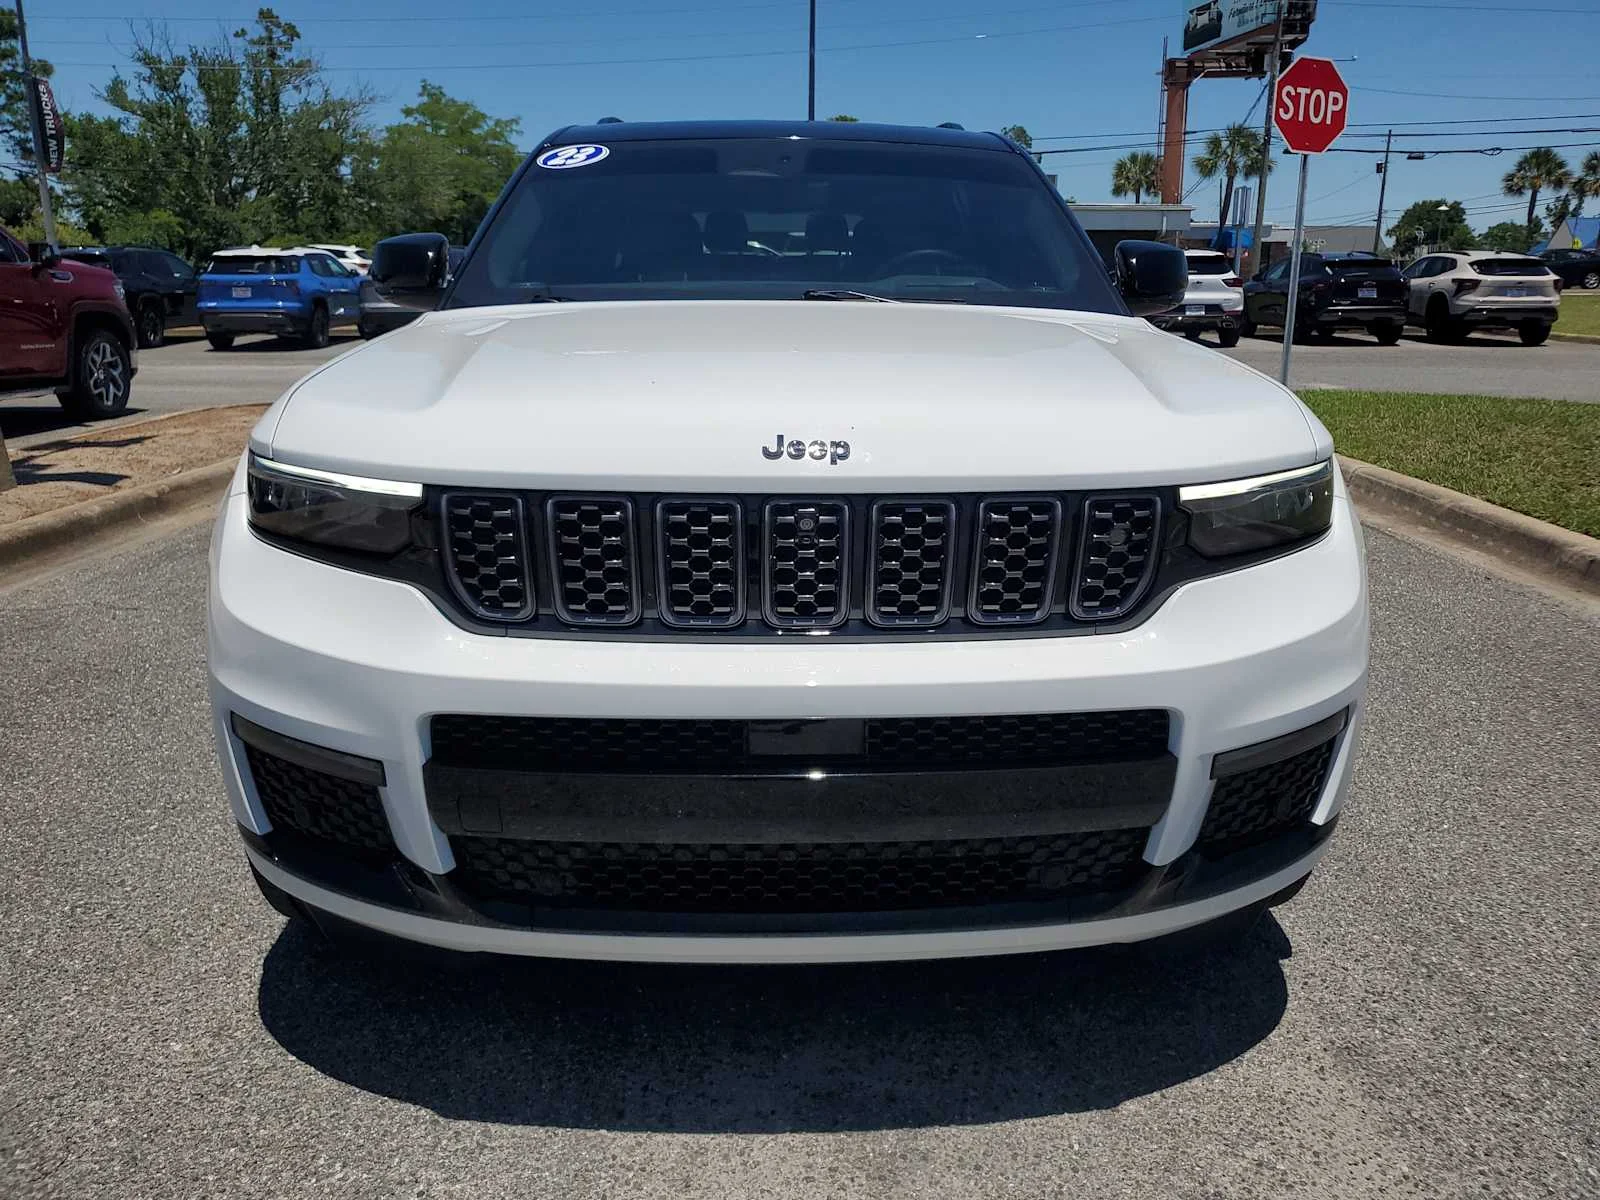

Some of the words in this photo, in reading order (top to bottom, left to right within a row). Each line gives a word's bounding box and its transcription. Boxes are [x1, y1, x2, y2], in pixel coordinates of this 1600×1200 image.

[39, 84, 56, 137] TRUCKS
[1279, 85, 1344, 125] STOP
[48, 139, 58, 168] NEW
[547, 147, 596, 166] 23
[762, 434, 851, 465] Jeep
